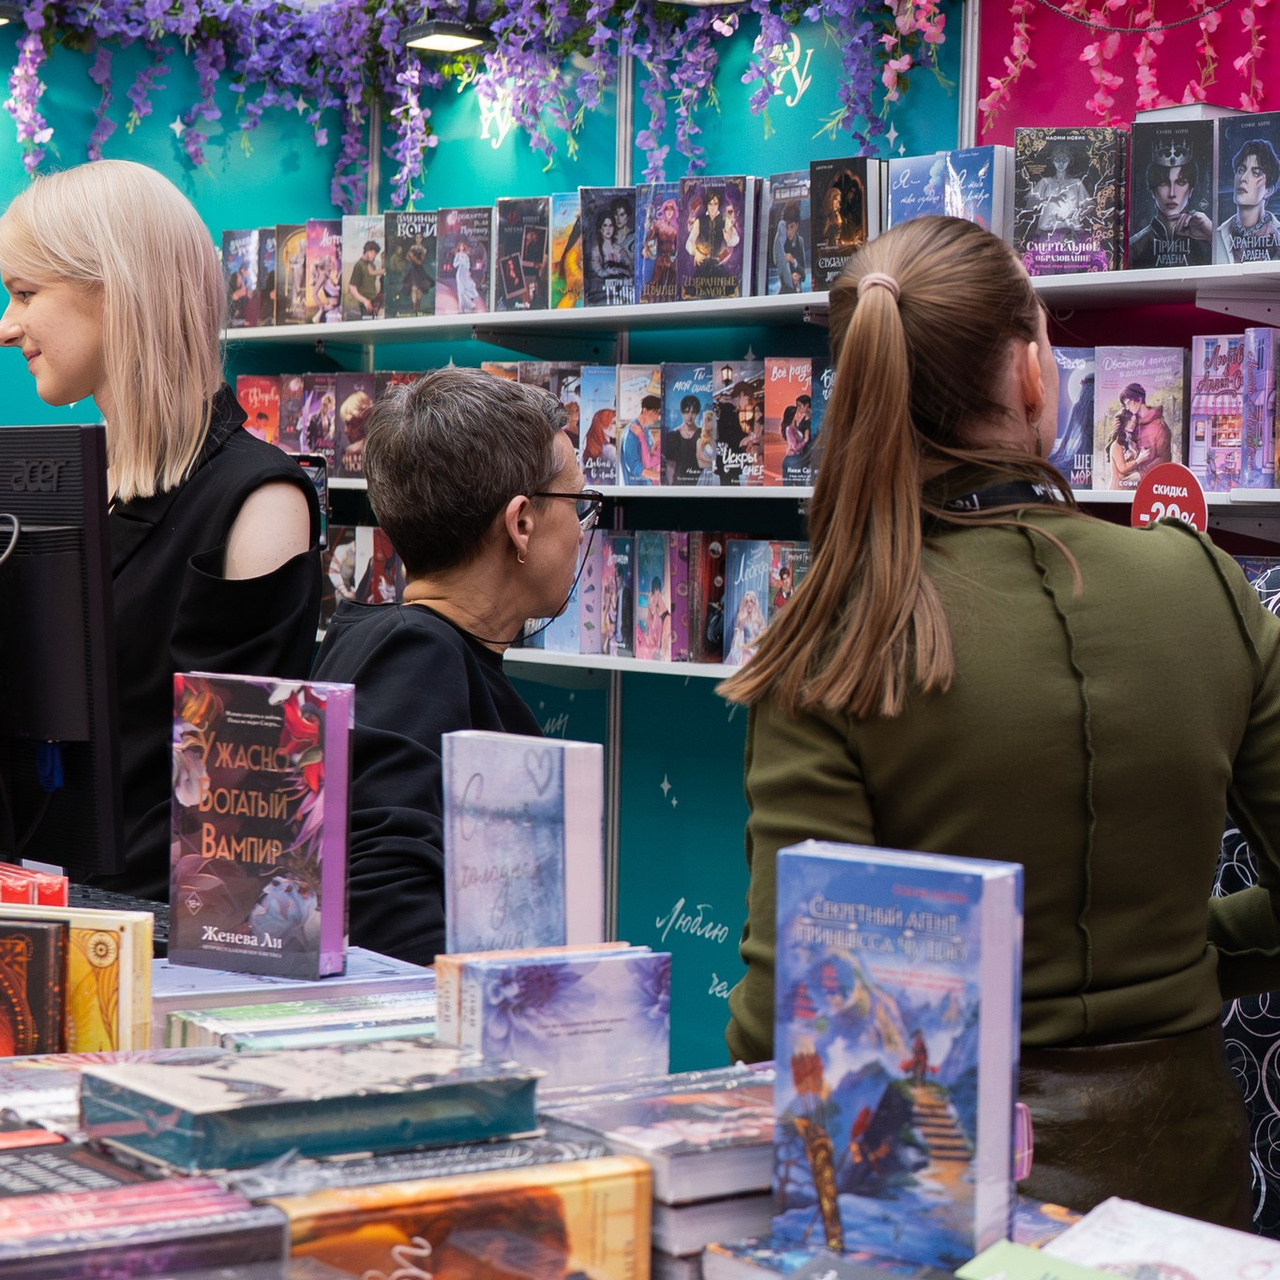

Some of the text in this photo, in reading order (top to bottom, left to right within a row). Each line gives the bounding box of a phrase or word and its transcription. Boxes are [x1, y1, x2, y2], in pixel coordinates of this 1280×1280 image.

[397, 222, 437, 238] БОГИ
[1026, 240, 1100, 253] СМЕРТЕЛЬНОЕ
[1153, 239, 1191, 257] ПРИНЦ
[1034, 252, 1091, 263] ОБРАЗОВАНИЕ
[1155, 254, 1188, 267] АРДЕНА
[1241, 248, 1271, 263] АРДЕНА
[722, 449, 758, 473] Искры
[11, 459, 66, 492] acer
[1153, 483, 1189, 497] СКИДКА
[655, 897, 729, 943] Люблю
[202, 926, 283, 949] Женева Ли
